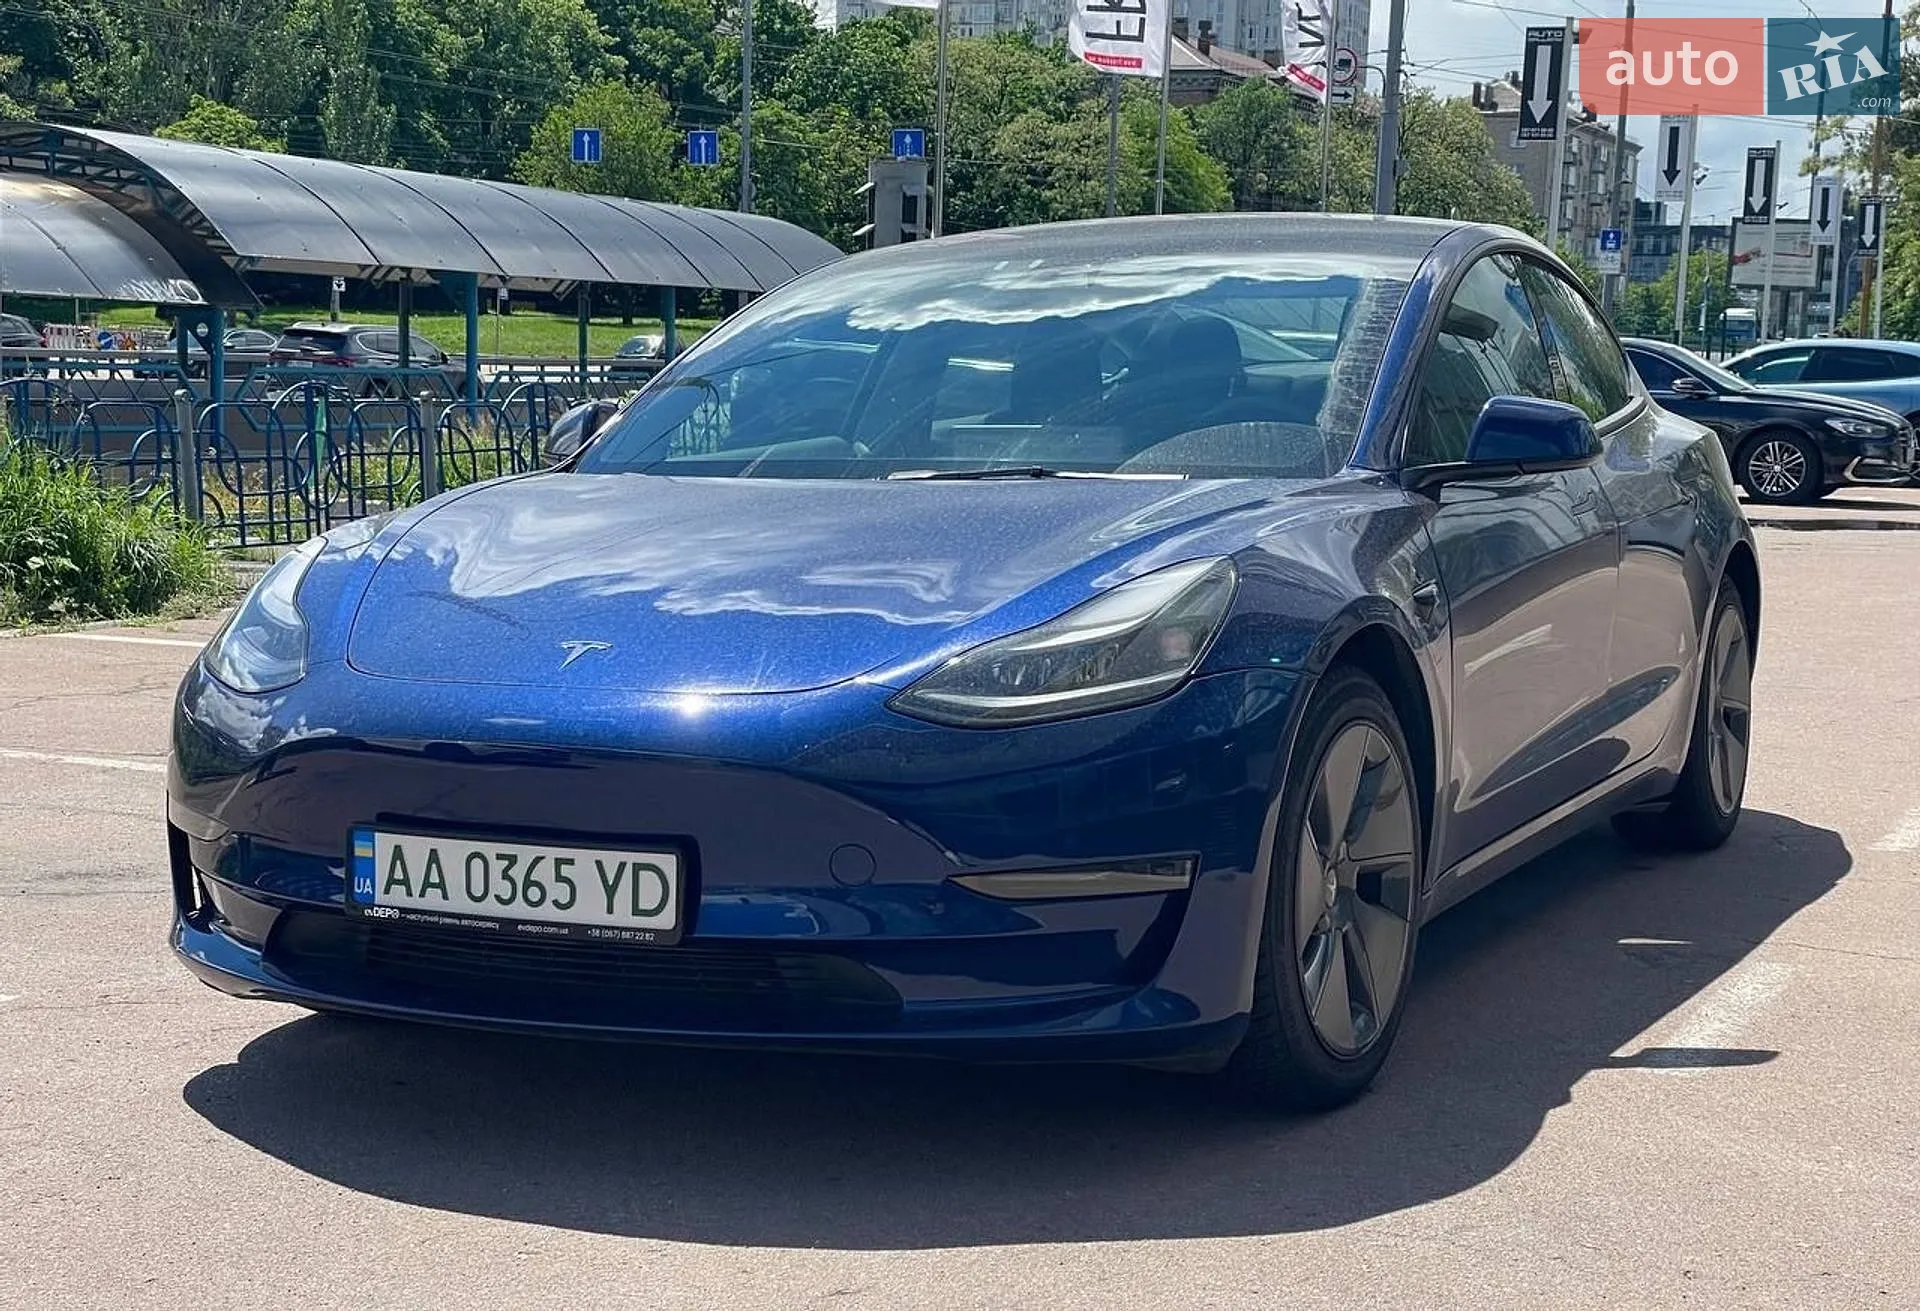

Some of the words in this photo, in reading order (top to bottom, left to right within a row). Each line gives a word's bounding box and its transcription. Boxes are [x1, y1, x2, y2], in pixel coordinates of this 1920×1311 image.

[353, 876, 373, 895] UA
[383, 844, 449, 900] AA
[464, 851, 577, 911] 0365
[594, 859, 670, 918] YD
